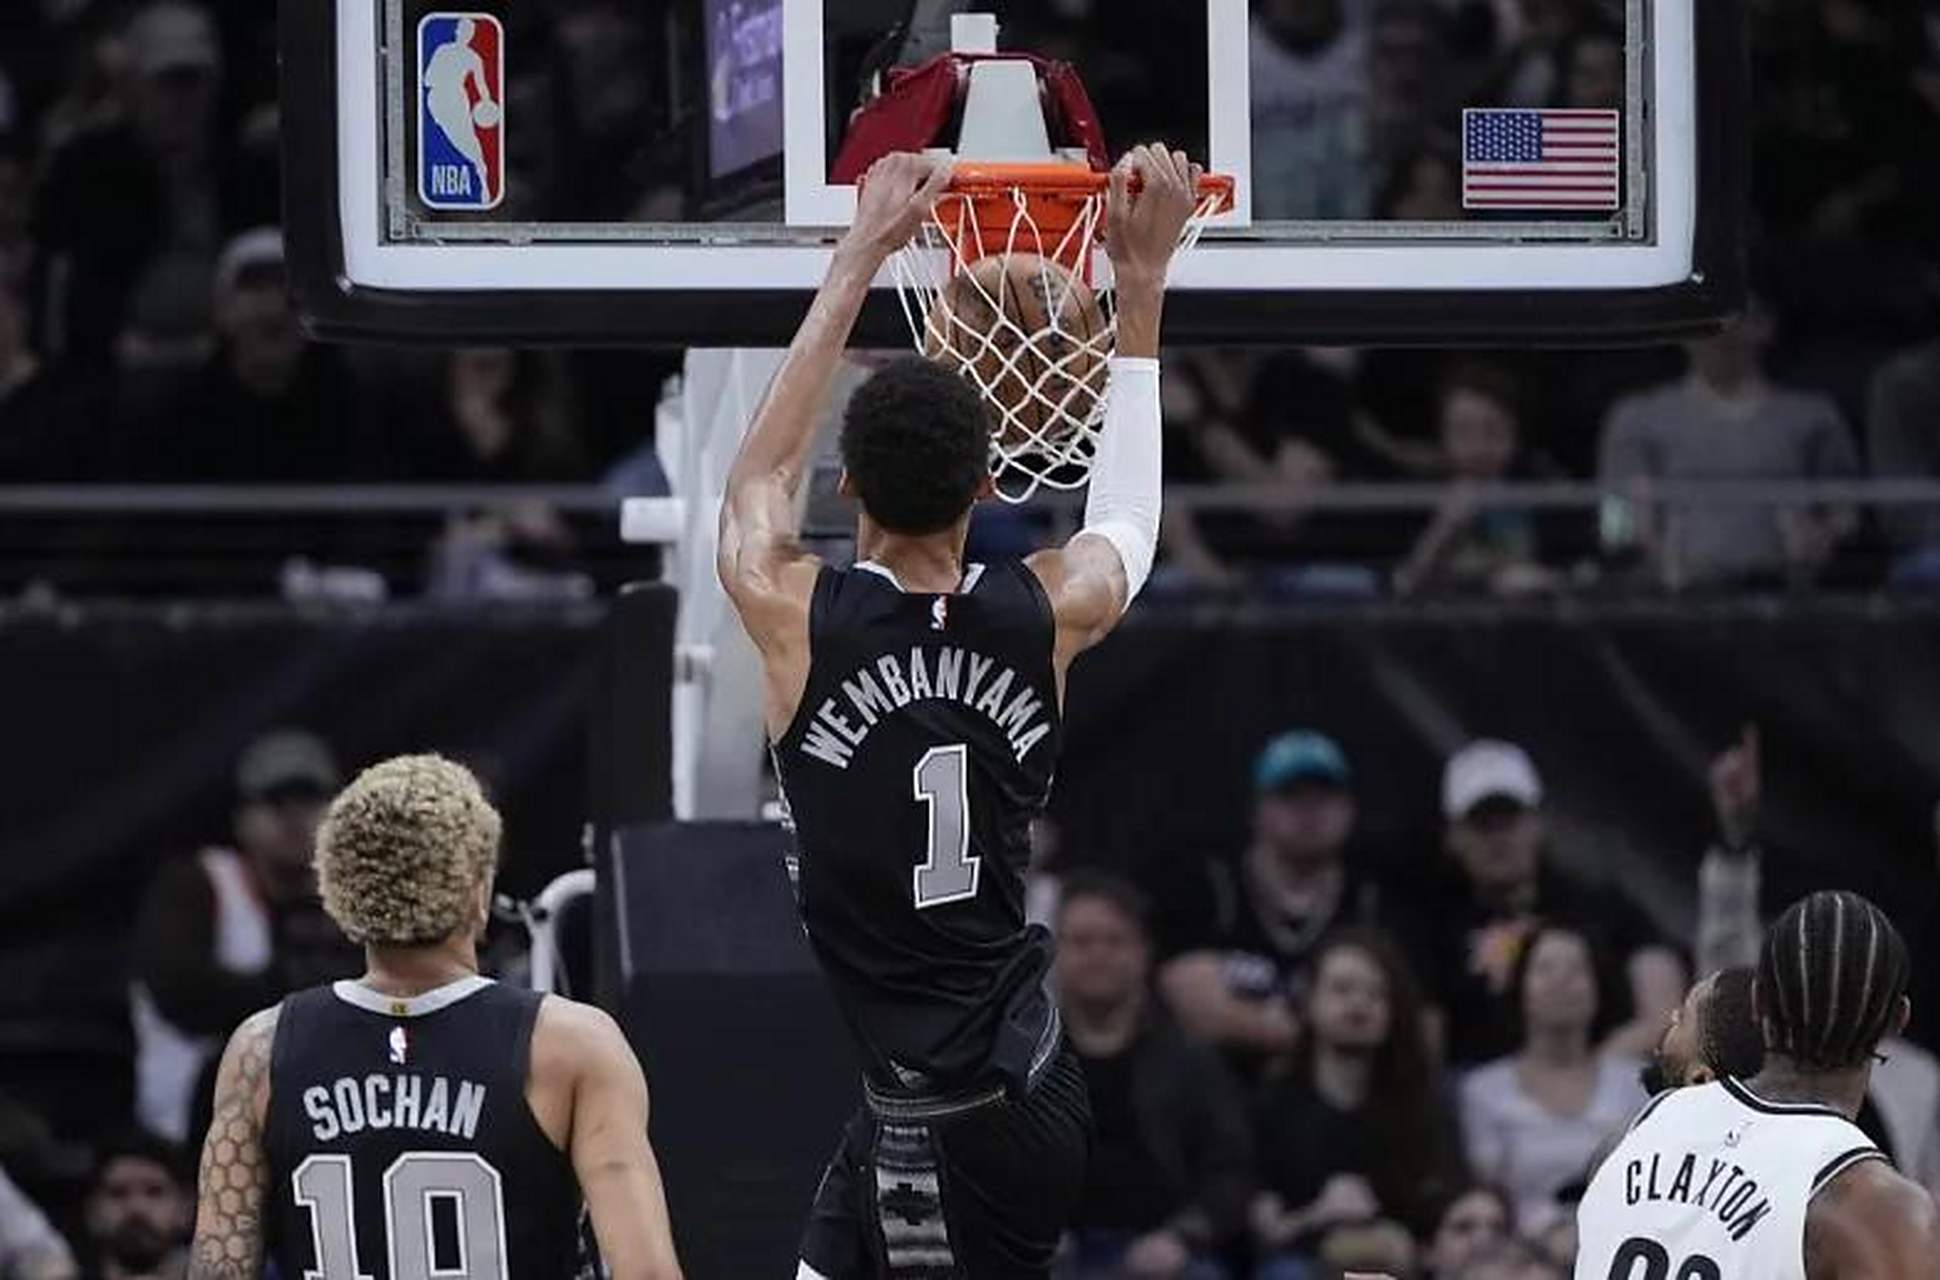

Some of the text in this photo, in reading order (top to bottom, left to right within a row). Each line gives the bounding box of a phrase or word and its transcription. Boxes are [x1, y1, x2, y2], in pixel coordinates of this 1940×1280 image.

[431, 164, 471, 196] NBA
[801, 647, 1049, 769] WEMBANYAMA
[913, 744, 981, 908] 1
[303, 1074, 486, 1141] SOCHAN
[292, 1151, 509, 1280] 10
[1626, 1154, 1771, 1242] CLAXTON
